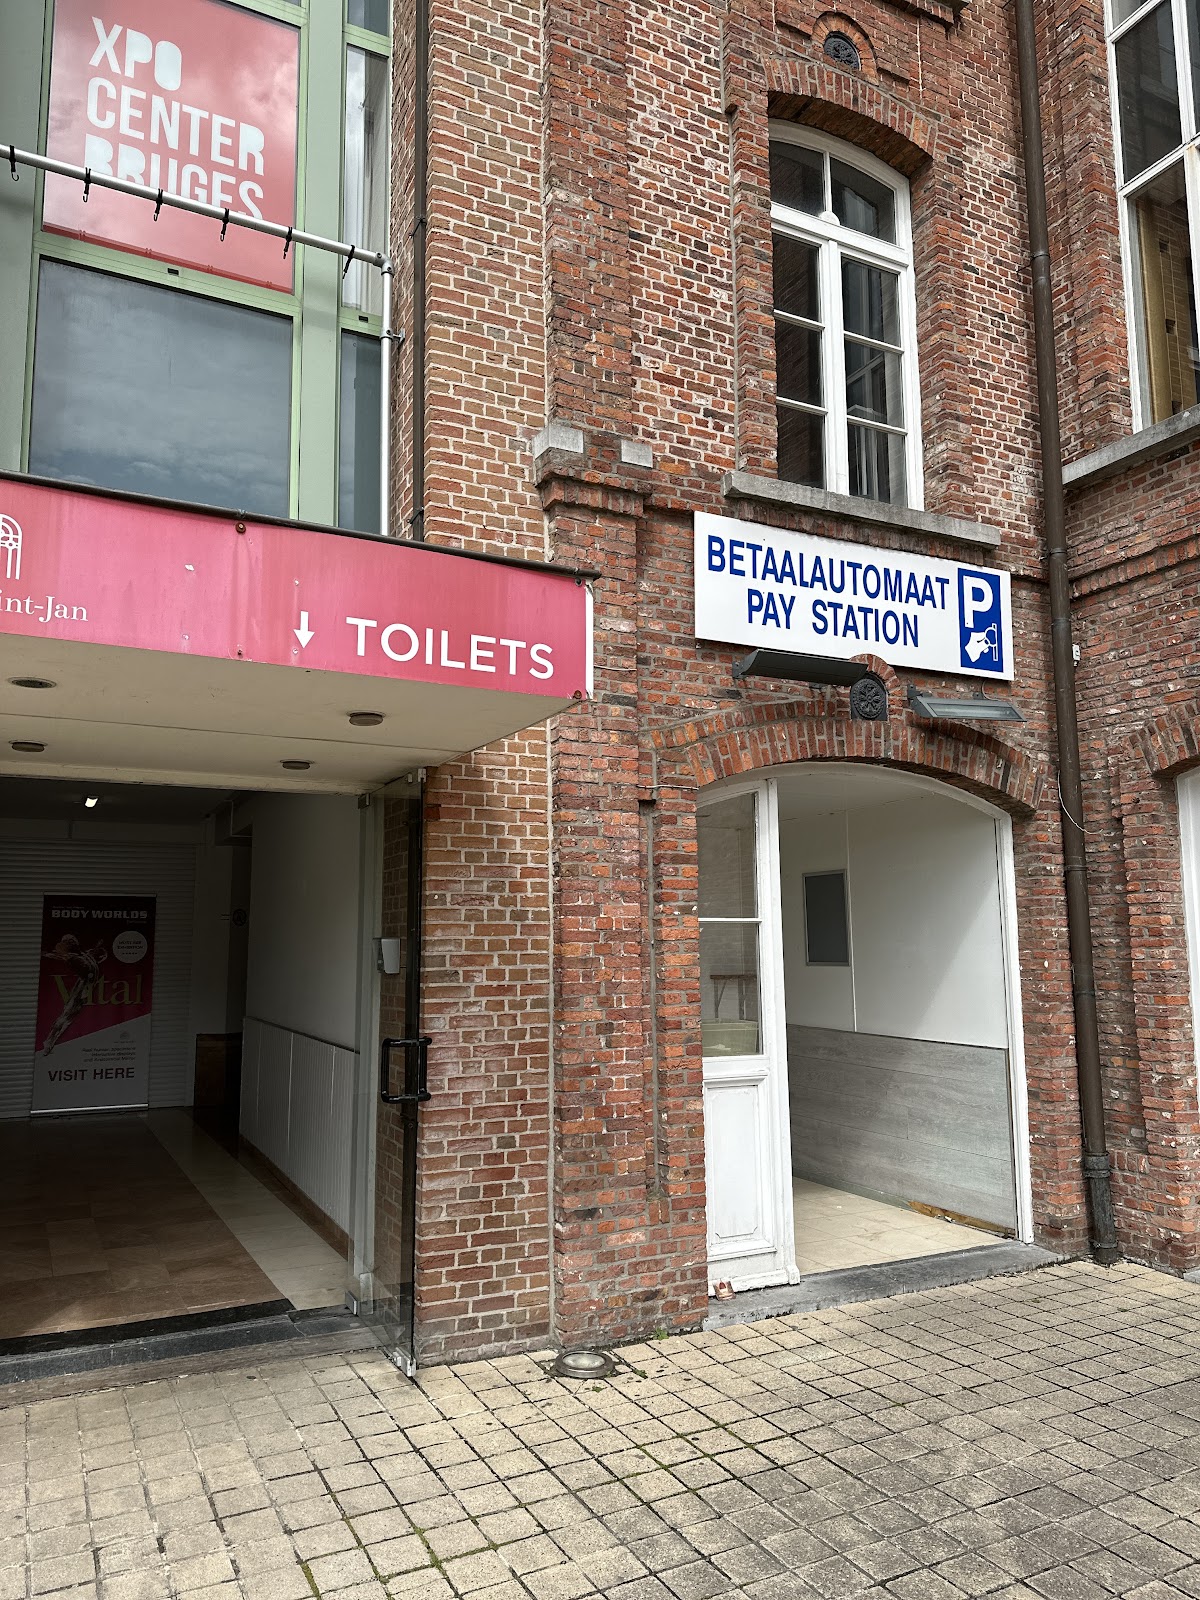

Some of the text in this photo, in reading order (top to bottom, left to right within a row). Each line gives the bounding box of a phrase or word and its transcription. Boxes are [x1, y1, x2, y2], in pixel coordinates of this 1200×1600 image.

[89, 16, 182, 92] XPO
[86, 76, 265, 176] CENTER
[85, 133, 264, 220] BRUGES
[708, 534, 950, 610] BETAALAUTOMAAT
[962, 575, 994, 629] P
[346, 616, 554, 681] TOILETS
[747, 588, 919, 648] PAY STATION
[51, 909, 148, 919] BODY WORLDS
[48, 974, 143, 1005] Vital
[48, 1067, 135, 1082] VISIT HERE
